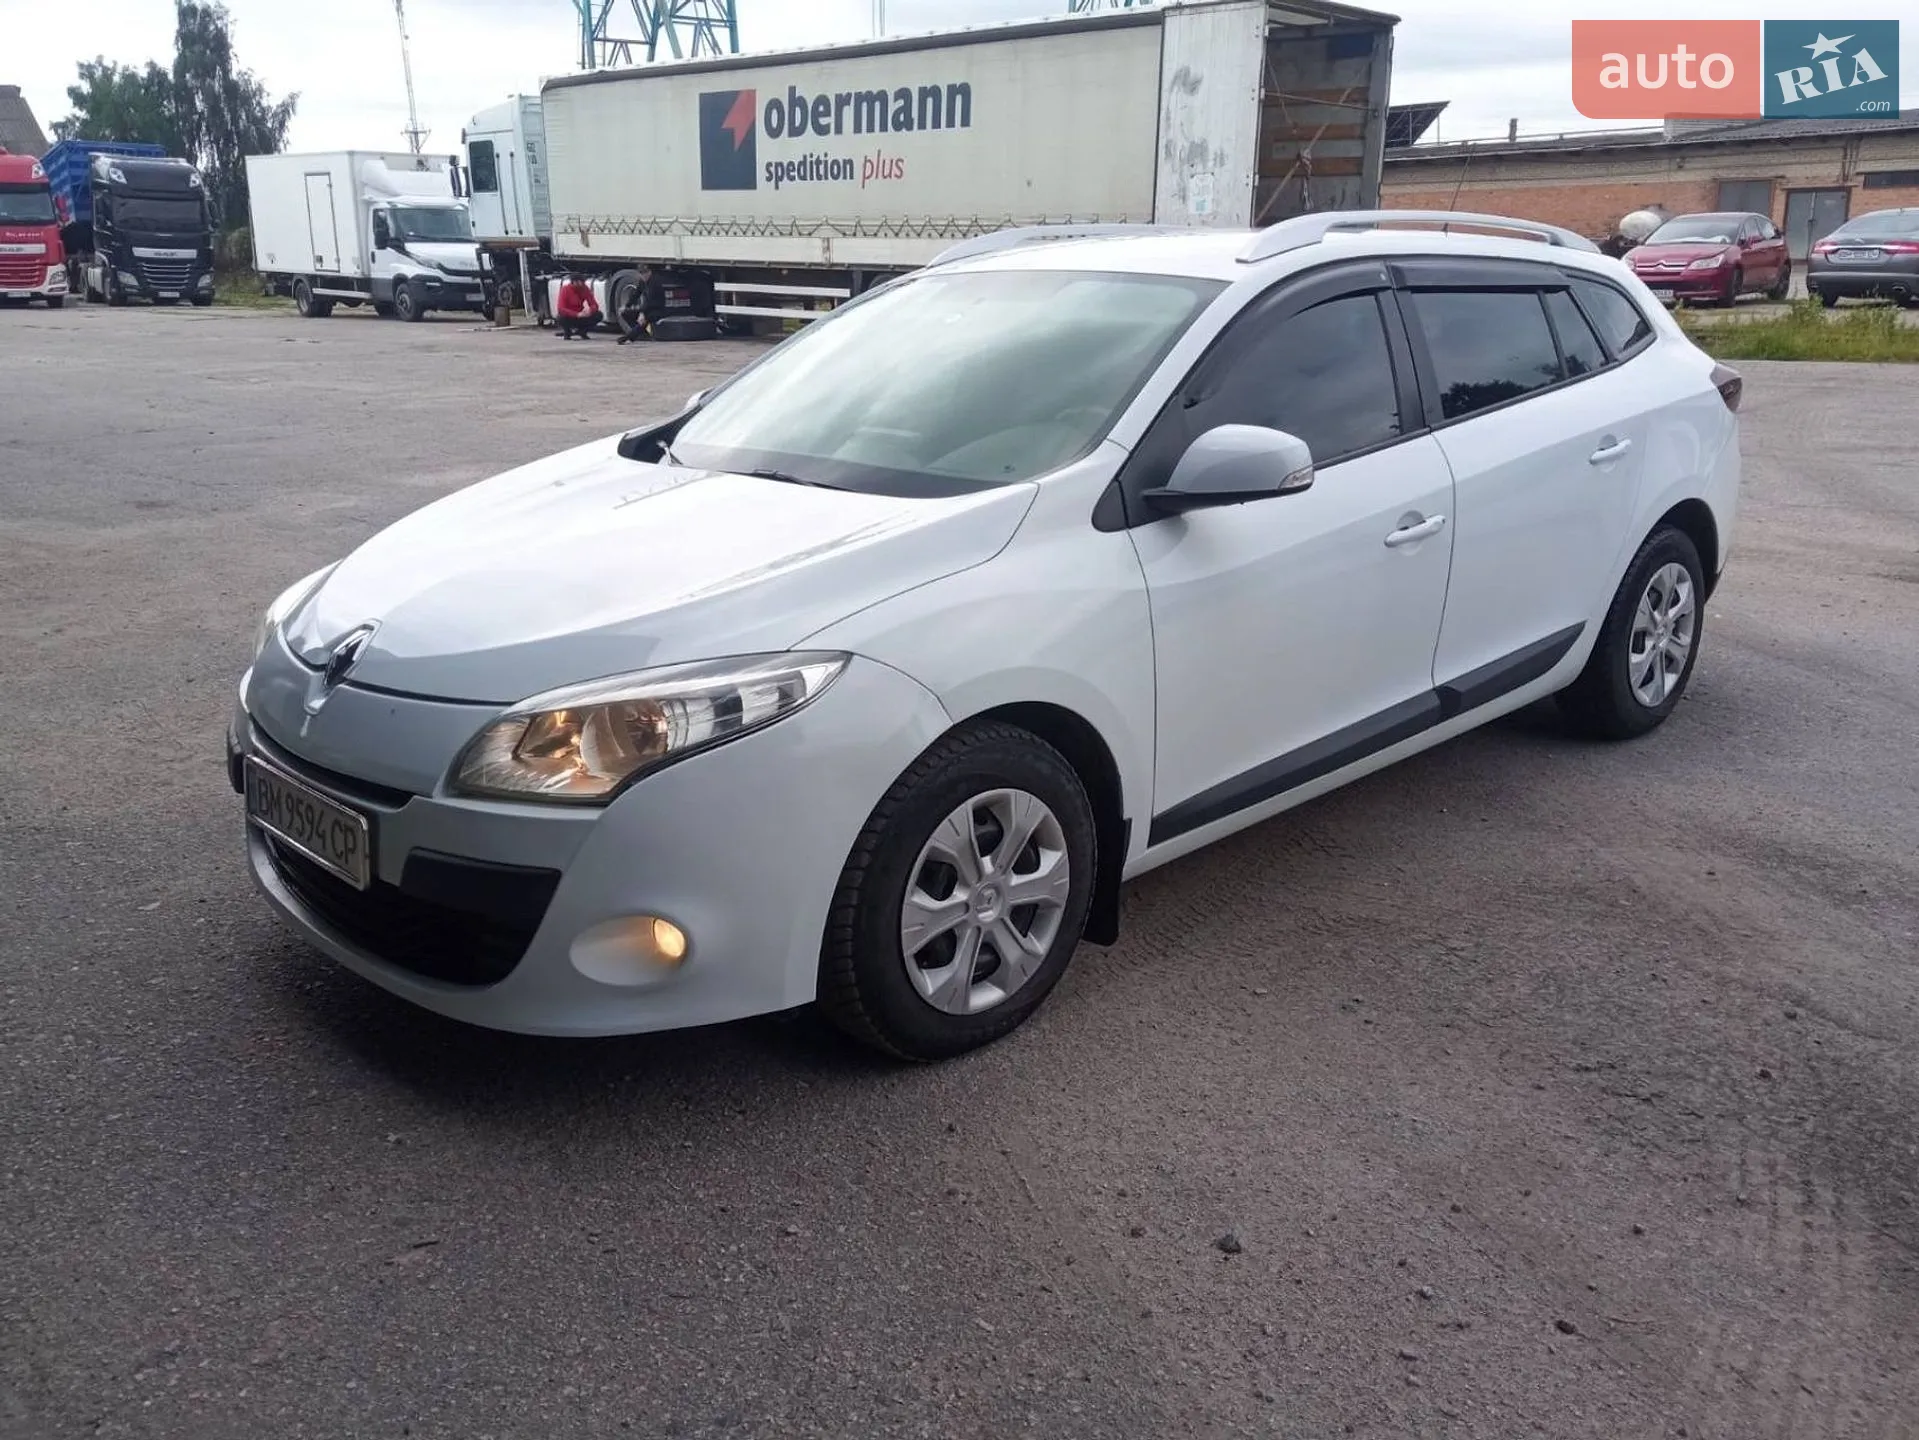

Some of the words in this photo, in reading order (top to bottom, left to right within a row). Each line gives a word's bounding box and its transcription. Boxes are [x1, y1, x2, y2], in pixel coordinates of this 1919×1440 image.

[764, 82, 971, 139] obermann
[765, 152, 854, 190] spedition
[862, 149, 904, 189] plus
[285, 791, 327, 851] 9594
[331, 819, 356, 864] CP
